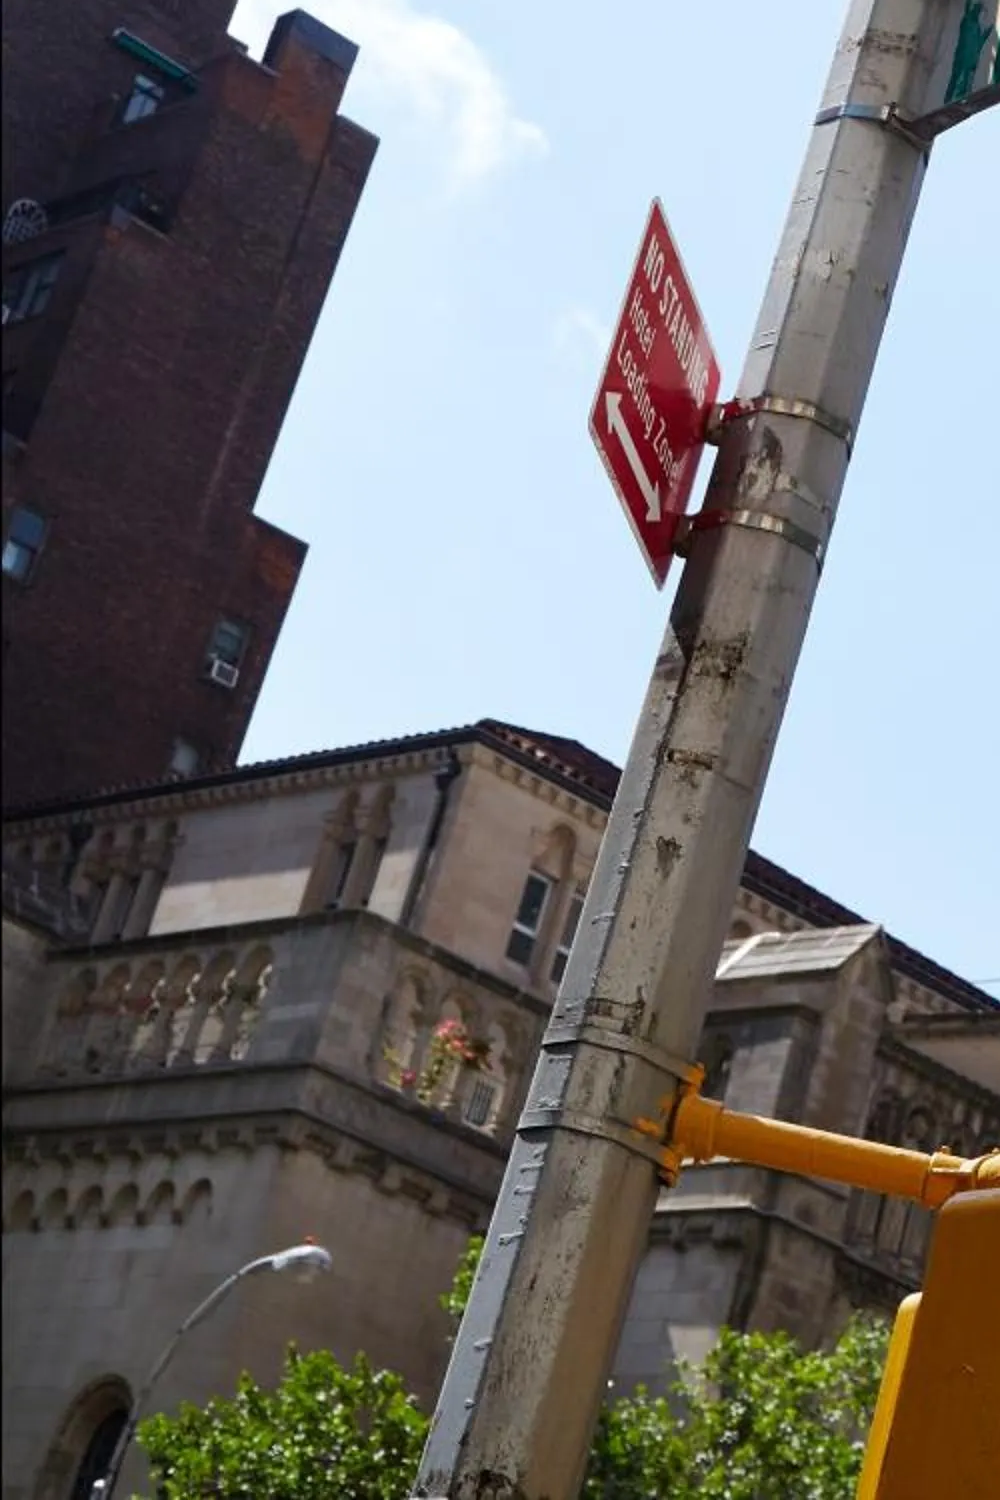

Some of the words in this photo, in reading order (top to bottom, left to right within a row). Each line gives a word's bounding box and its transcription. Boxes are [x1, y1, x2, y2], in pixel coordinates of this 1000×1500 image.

[629, 286, 657, 360] Hotel
[644, 233, 665, 293] NO
[660, 275, 709, 410] STANDING
[617, 329, 656, 440] Loading
[653, 417, 683, 489] Zone
